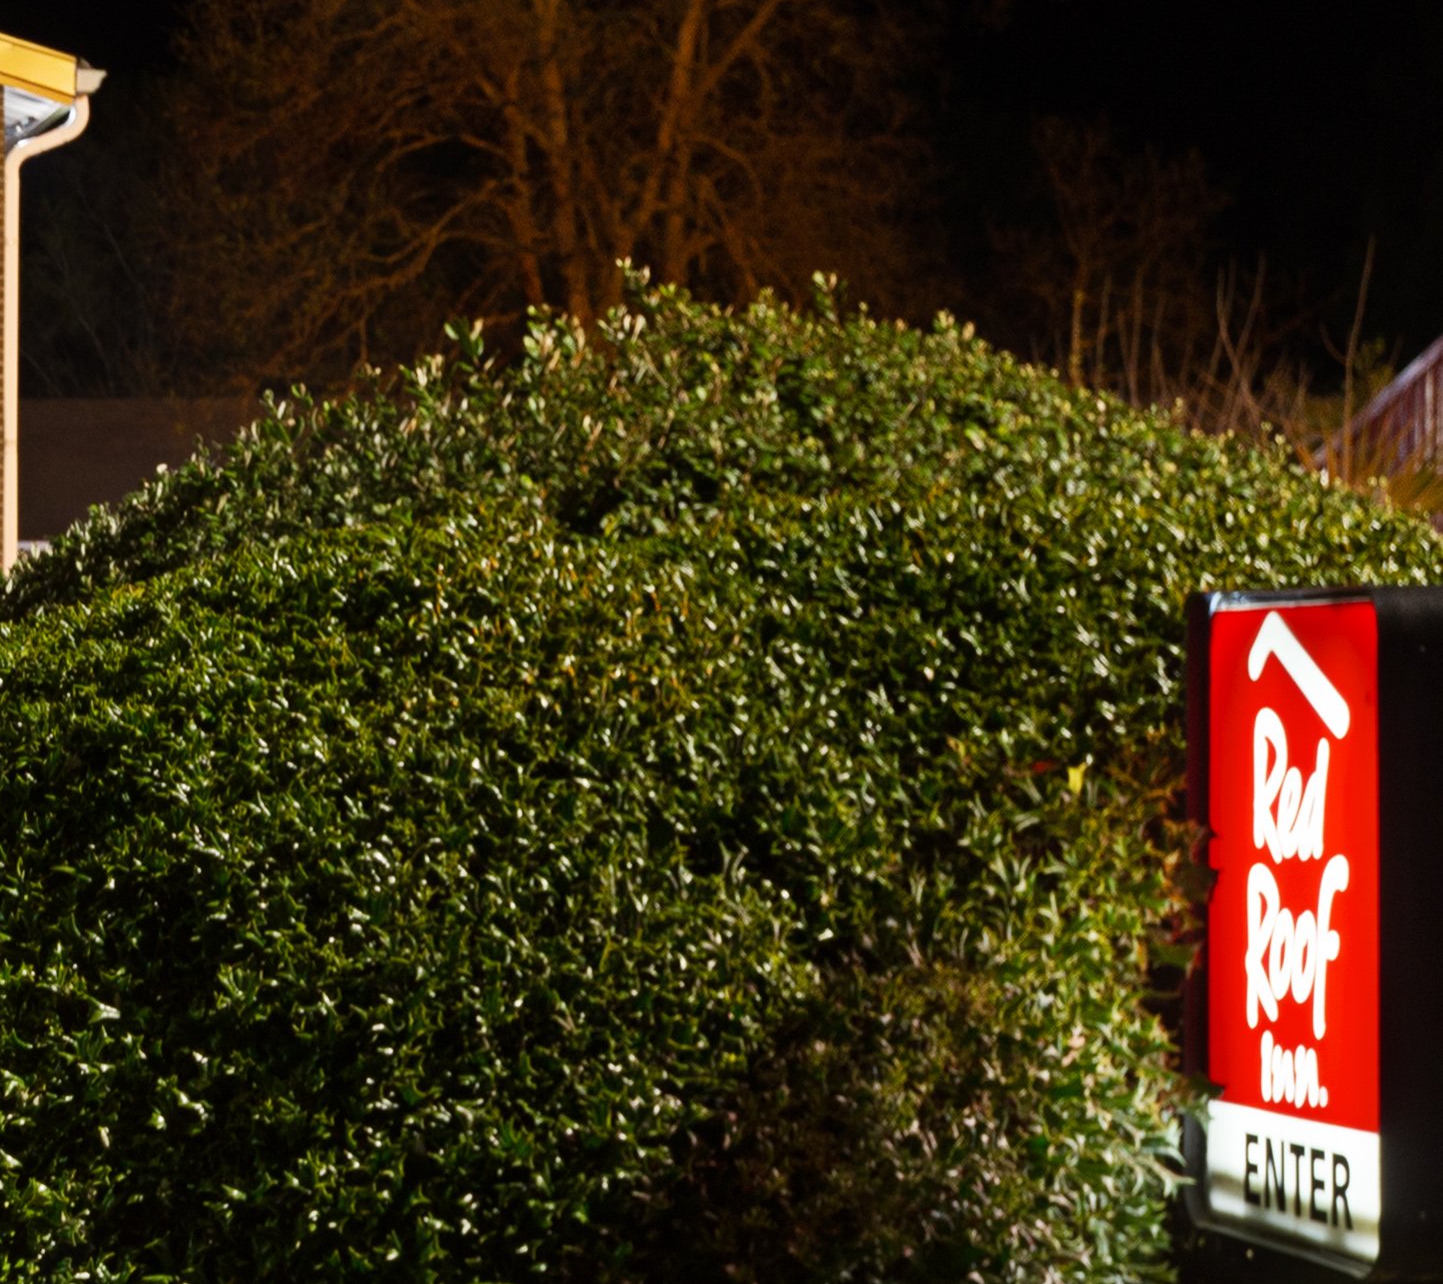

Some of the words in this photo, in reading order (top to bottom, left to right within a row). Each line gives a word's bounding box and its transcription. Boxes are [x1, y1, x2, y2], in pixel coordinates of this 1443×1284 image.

[1252, 707, 1330, 864] Red
[1245, 854, 1350, 1040] Roof
[1243, 1133, 1354, 1232] ENTER
